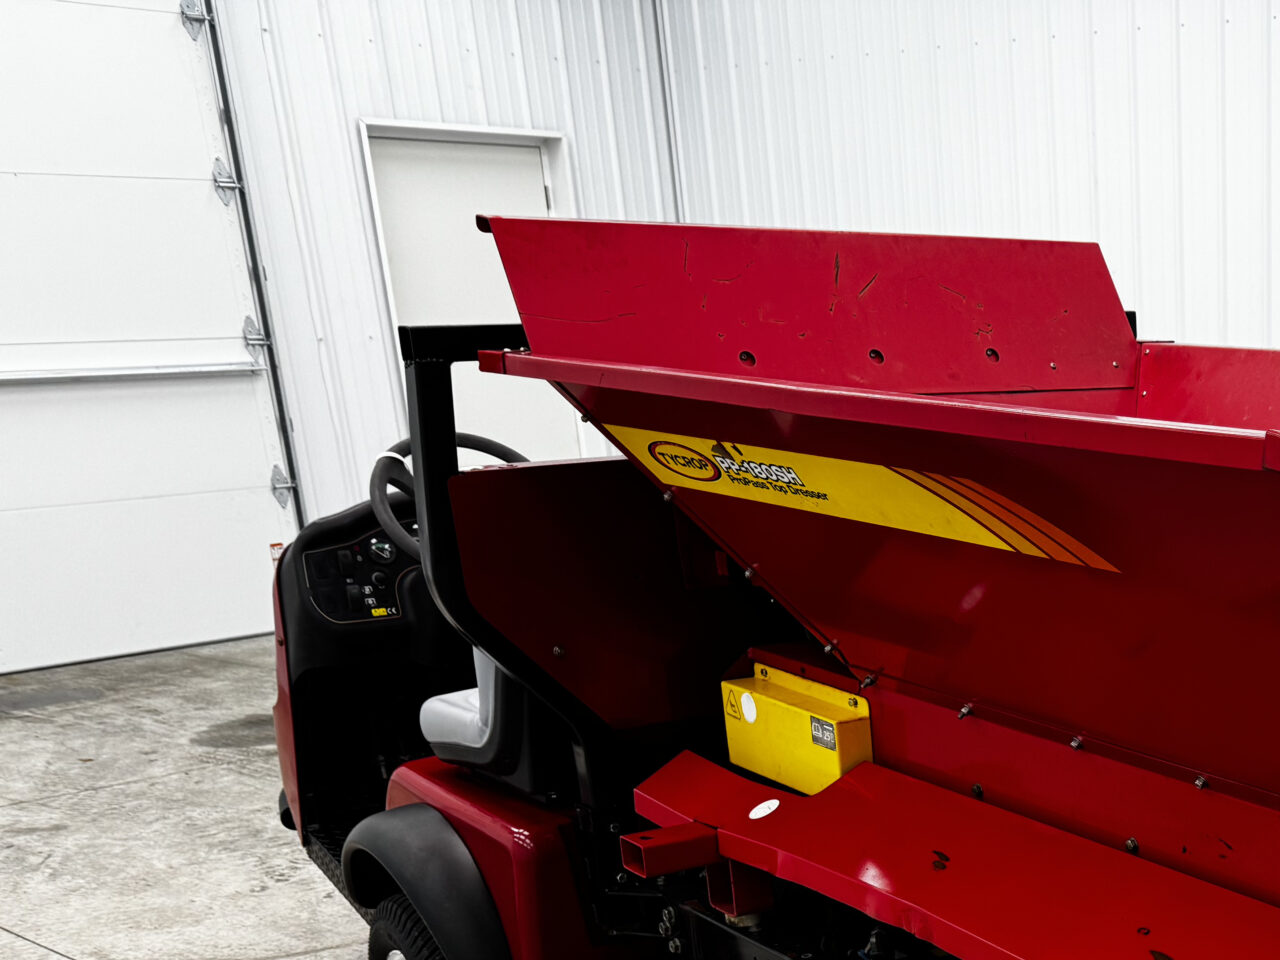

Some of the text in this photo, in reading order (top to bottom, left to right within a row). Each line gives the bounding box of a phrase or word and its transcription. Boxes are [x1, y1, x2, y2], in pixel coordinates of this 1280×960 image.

[657, 452, 709, 471] TYCROP
[712, 455, 805, 487] PP-180SH
[727, 474, 829, 500] ProPass Top Dresser
